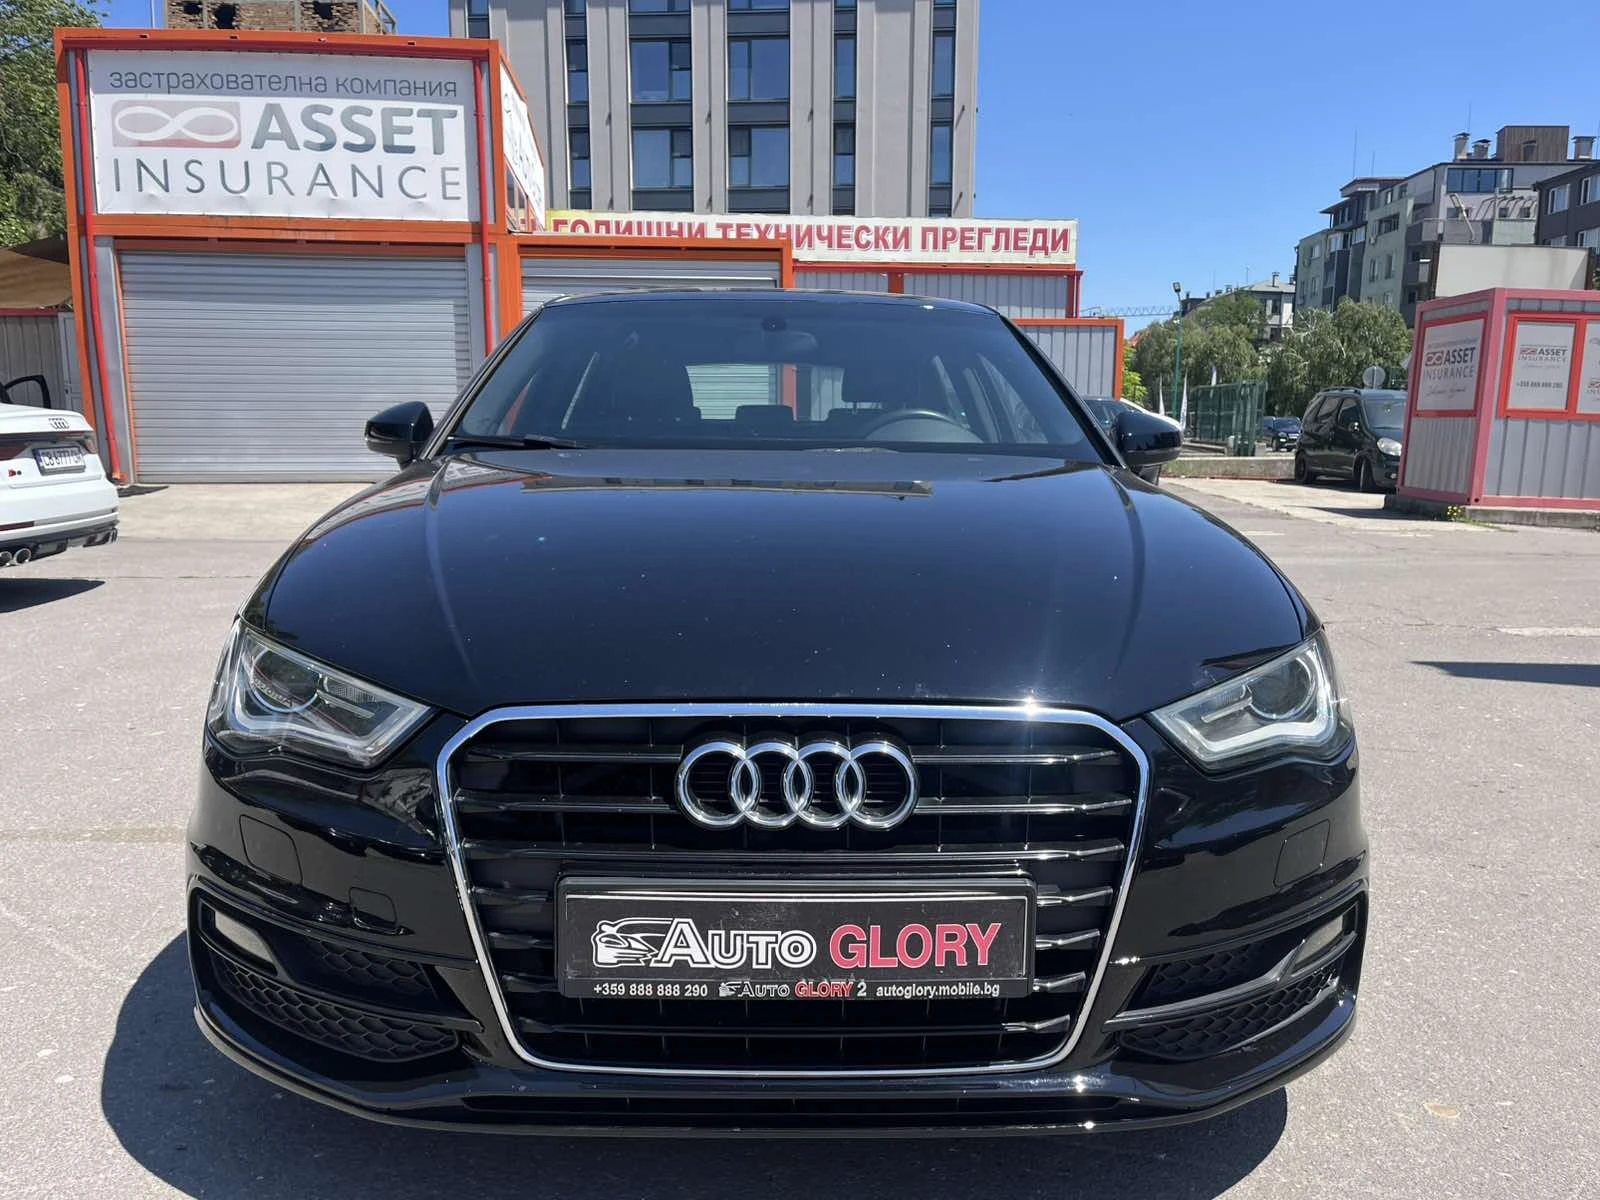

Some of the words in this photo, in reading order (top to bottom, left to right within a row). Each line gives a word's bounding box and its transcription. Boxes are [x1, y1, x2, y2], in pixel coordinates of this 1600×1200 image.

[109, 70, 328, 94] застрахователна
[336, 74, 458, 98] компания
[250, 102, 458, 156] ASSET
[113, 157, 462, 201] INSURANCE
[715, 222, 911, 251] ТЕХНИЧЕСКИ
[920, 226, 1071, 256] ПРЕГЛЕДИ
[1443, 346, 1477, 365] ASSET
[1538, 348, 1568, 356] ASSET
[828, 922, 1003, 969] GLORY
[593, 982, 626, 996] +359
[629, 983, 653, 996] 888
[656, 983, 681, 997] 888
[684, 983, 708, 997] 290
[794, 981, 854, 998] GLORY
[856, 981, 867, 997] 2
[876, 981, 1001, 999] autoglory.mobile.bg
